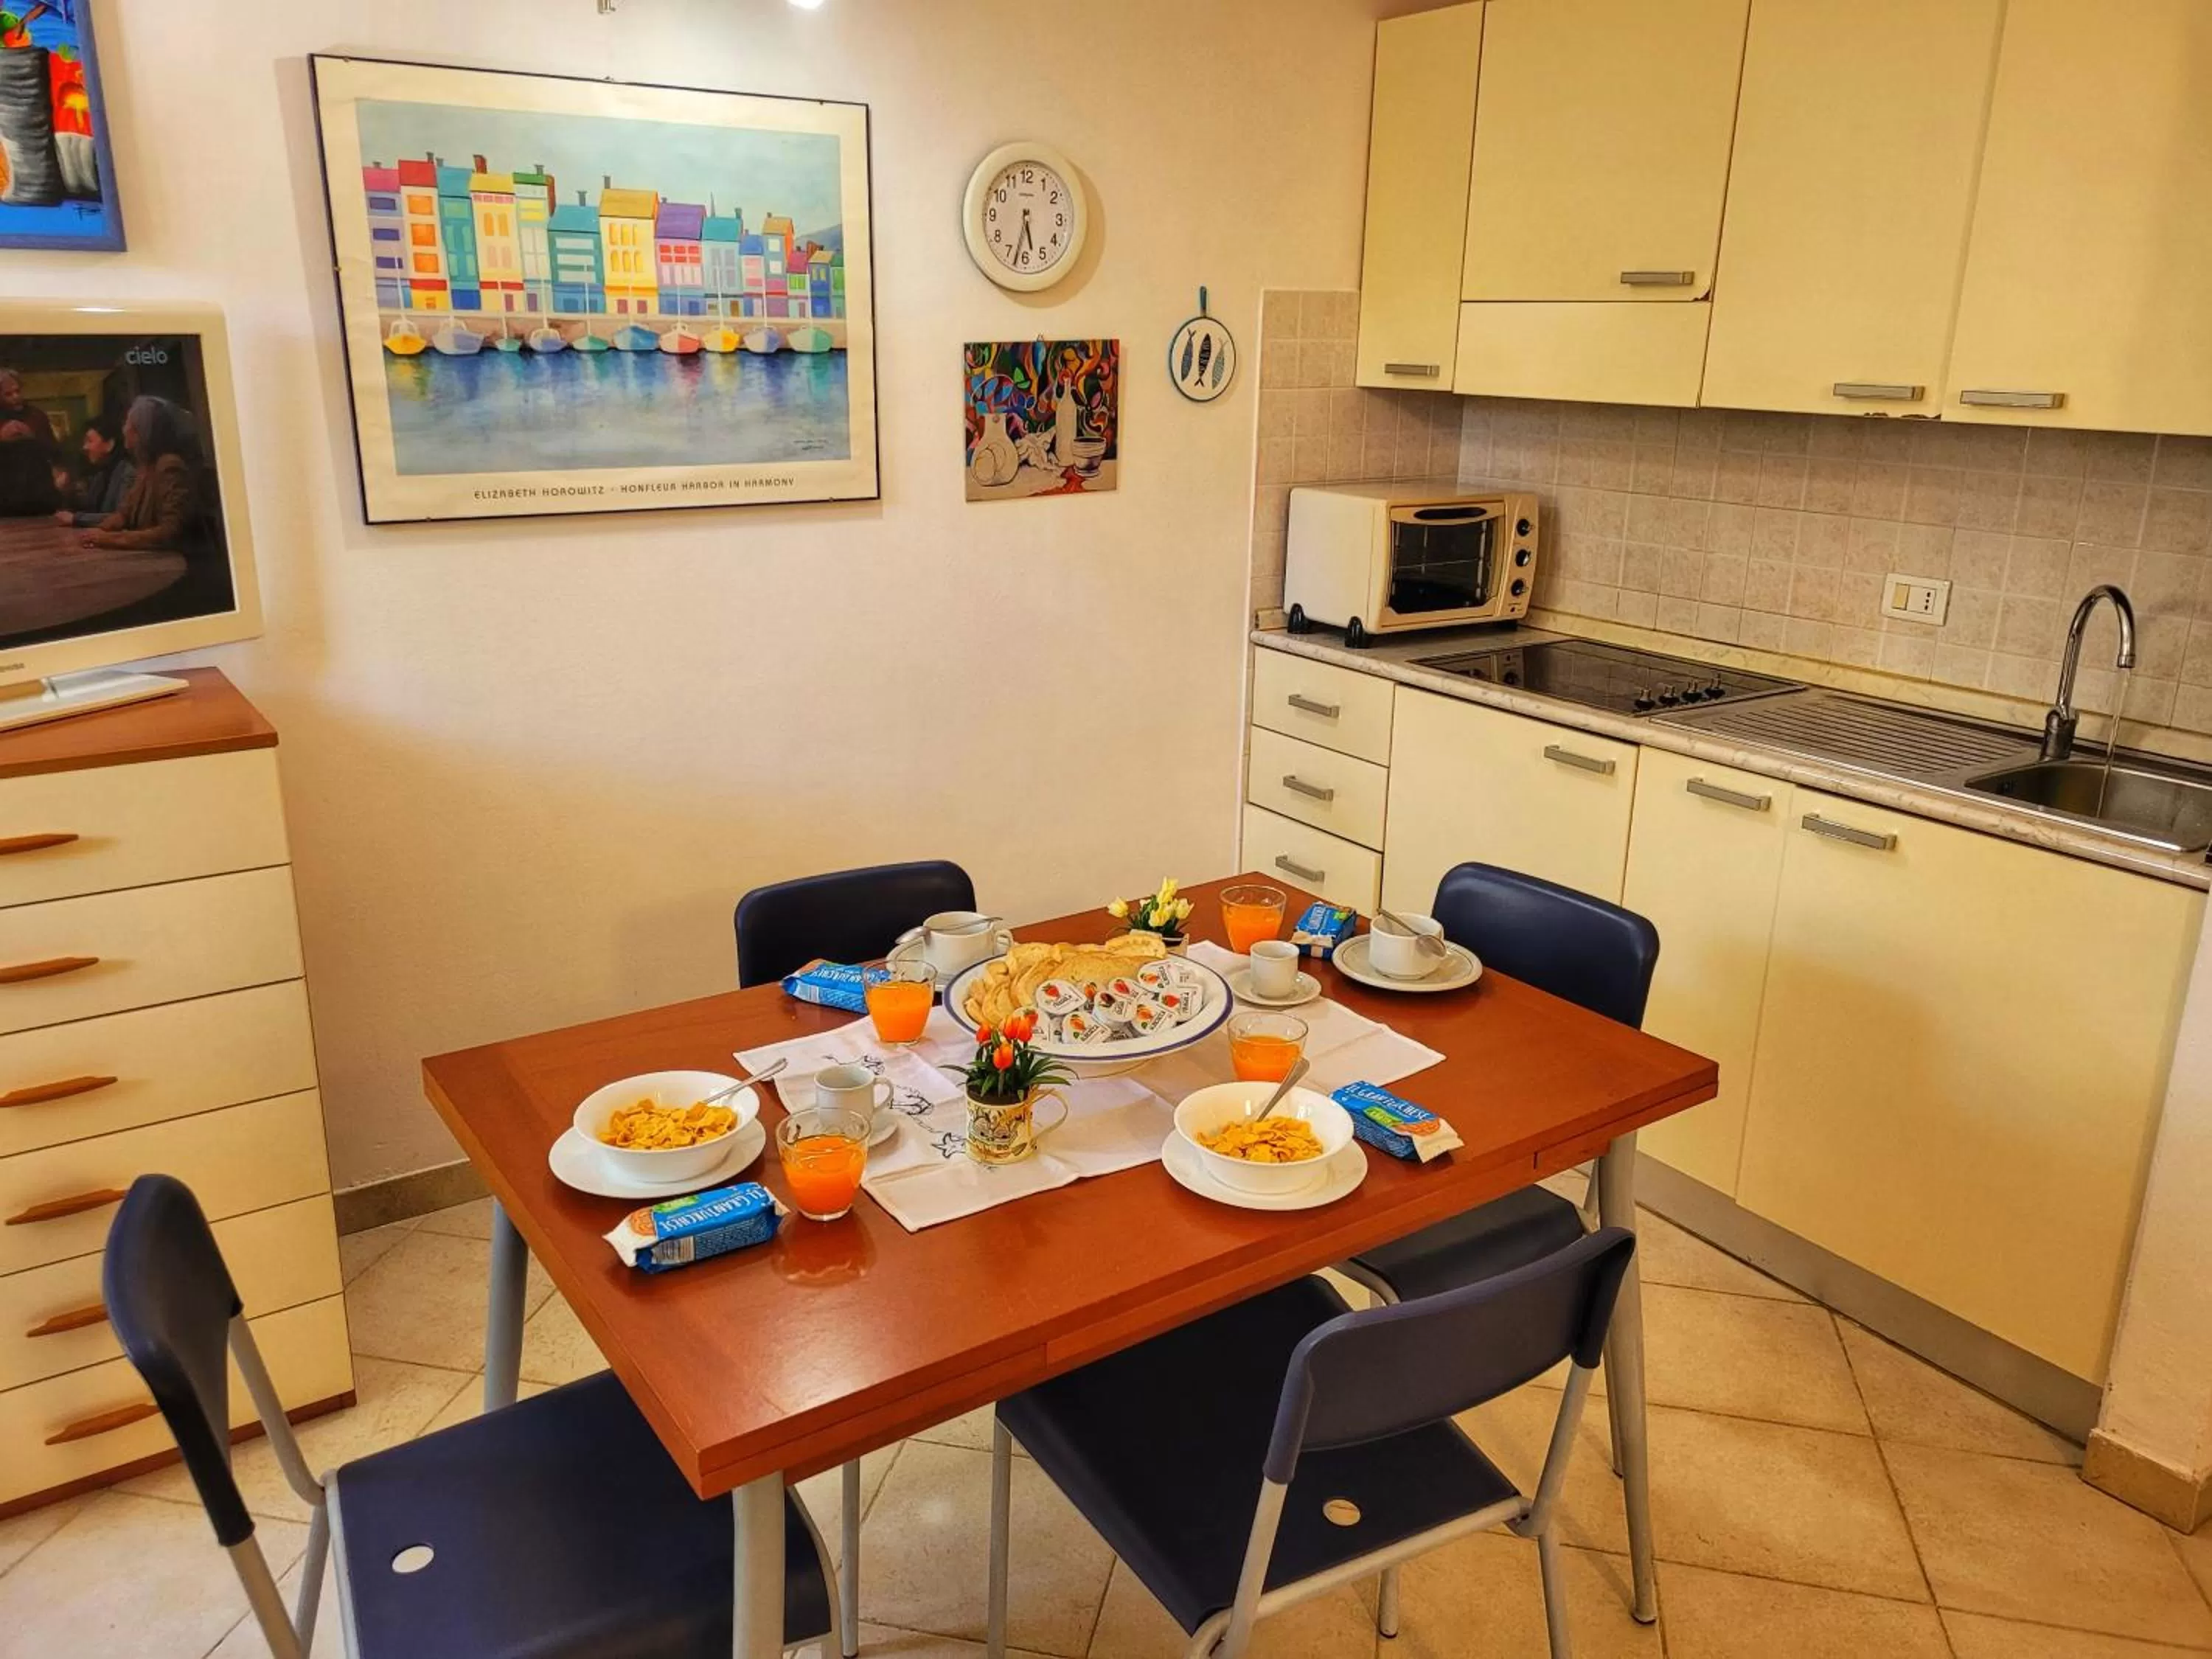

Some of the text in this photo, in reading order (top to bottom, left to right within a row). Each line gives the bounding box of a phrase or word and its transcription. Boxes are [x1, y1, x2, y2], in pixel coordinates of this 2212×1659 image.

[1006, 174, 1016, 188] 11
[1020, 169, 1033, 184] 12
[1040, 177, 1046, 192] 1
[993, 188, 1007, 203] 10
[1049, 190, 1058, 204] 2
[989, 207, 996, 222] 9
[1055, 213, 1062, 226] 3
[993, 229, 1002, 243] 8
[1049, 232, 1057, 246] 4
[1004, 244, 1013, 257] 7
[1038, 247, 1046, 260] 5
[1021, 251, 1029, 265] 6
[125, 346, 168, 365] cielo
[474, 478, 795, 500] ELIZABETH HOROWITZ HONFLEUR HARBOR IN HARMONY
